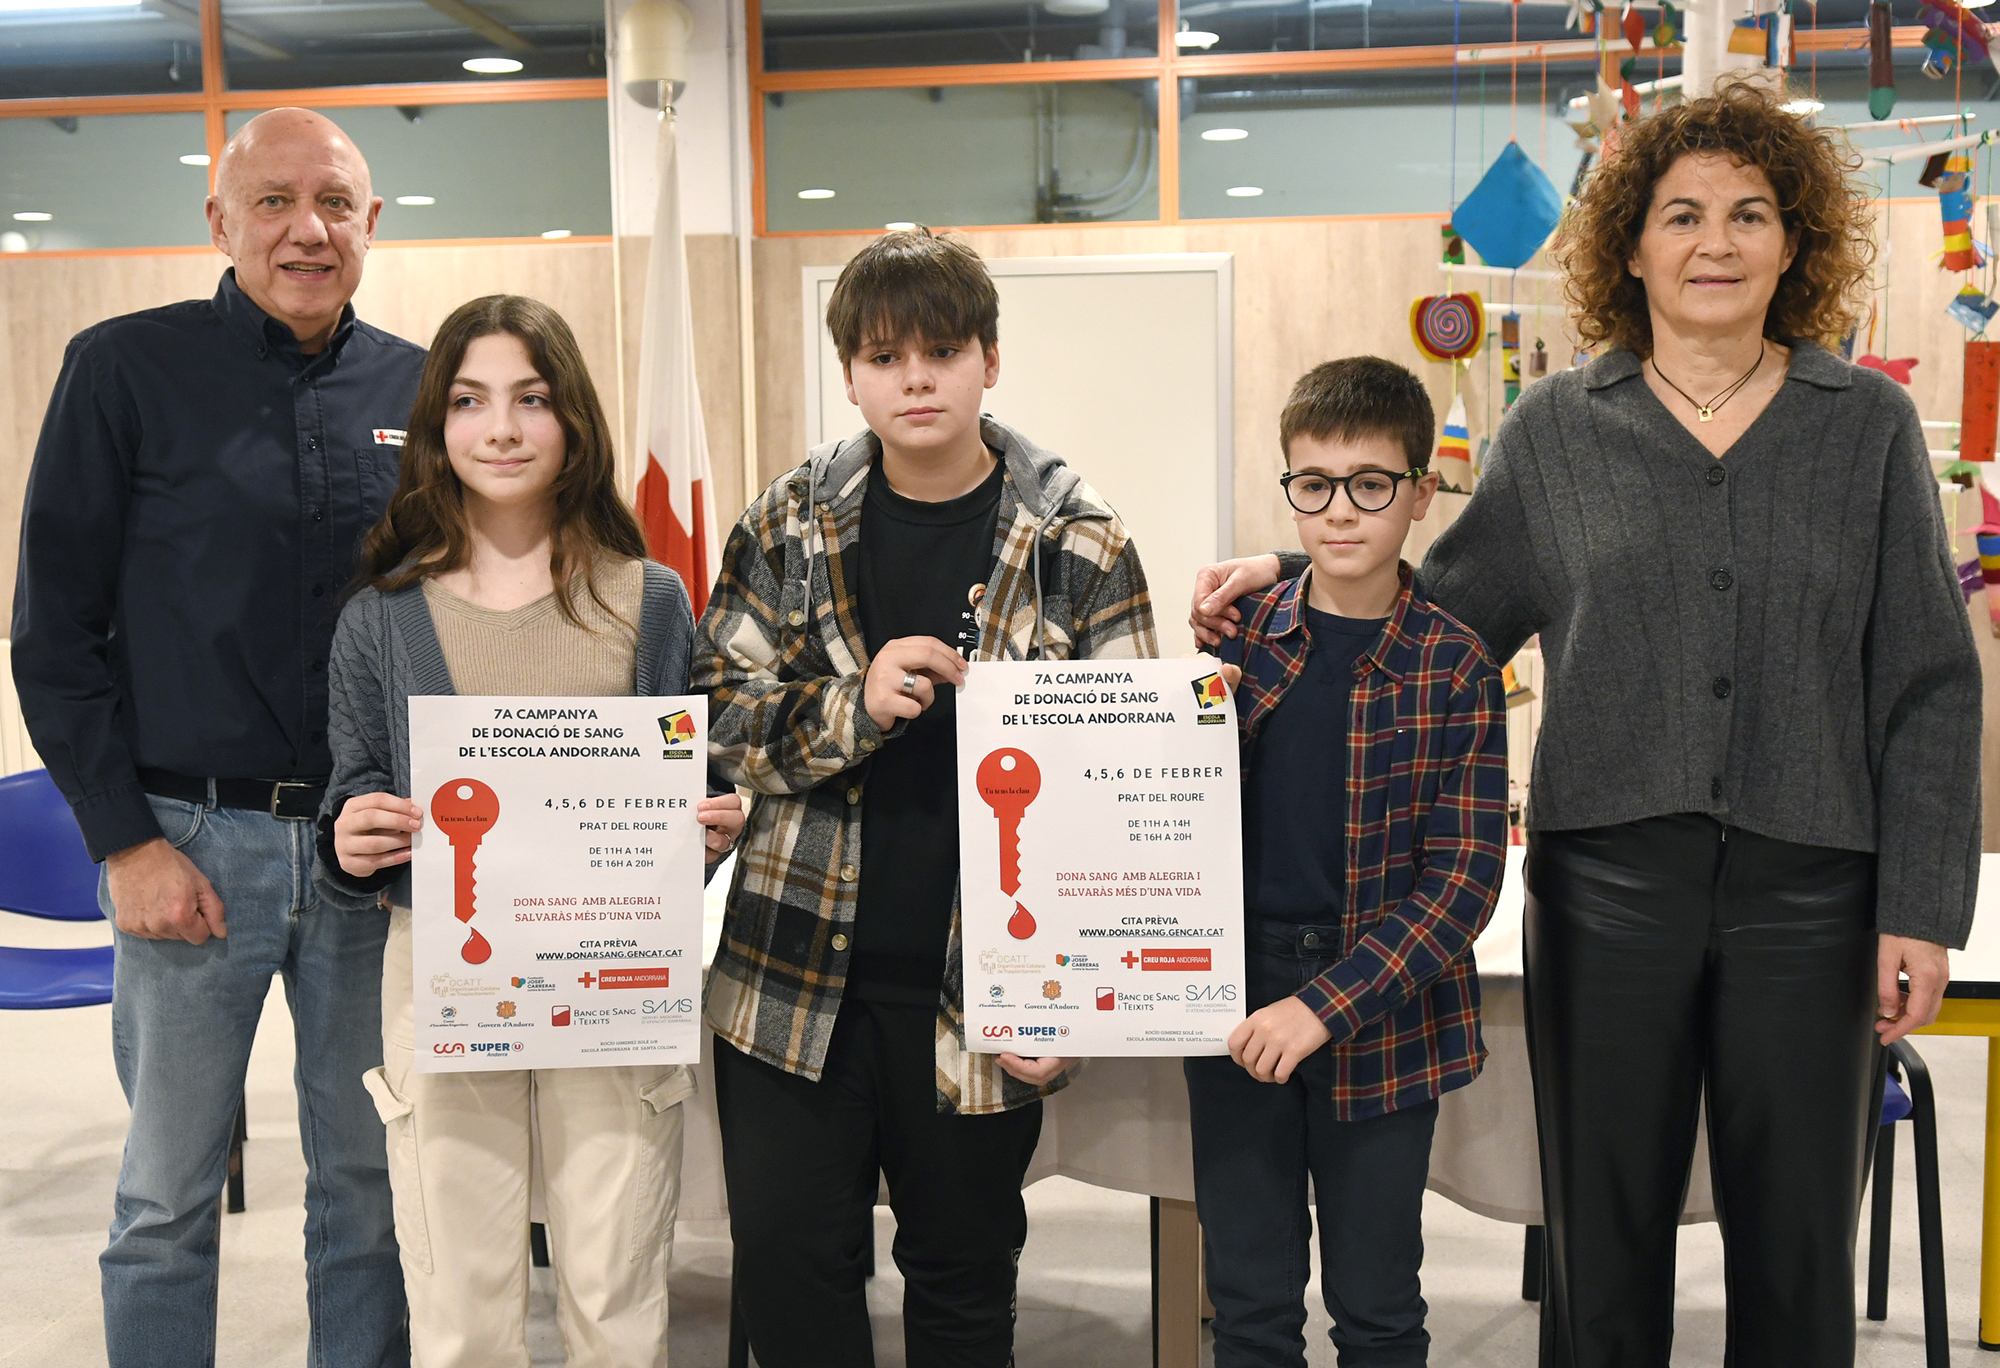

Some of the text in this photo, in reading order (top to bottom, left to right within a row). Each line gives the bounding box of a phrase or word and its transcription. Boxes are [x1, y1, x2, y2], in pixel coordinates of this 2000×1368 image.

[1035, 672, 1134, 685] 7A CAMPANYA
[1014, 690, 1158, 705] DE DONACIÓ DE SANG
[494, 708, 598, 720] 7A CAMPANYA
[1002, 712, 1176, 725] DE L'ESCOLA ANDORRANA
[472, 725, 624, 738] DE DONACIÓ DE SANG
[459, 747, 640, 758] DE L'ESCOLA ANDORRANA
[1084, 766, 1223, 782] 4,5,6 DE FEBRER
[1118, 793, 1204, 802] PRAT DEL ROURE
[545, 798, 688, 810] 4,5,6 DE FEBRER
[580, 822, 668, 831] PRAT DEL ROURE
[1128, 819, 1190, 828] DE 11H A 14H
[1130, 832, 1192, 842] DE 16H A 20H
[590, 847, 653, 855] DE 11H A 14H
[590, 860, 654, 868] DE 16H A 20H
[1056, 872, 1200, 881] DONA SANG AMB ALEGRIA I
[1058, 886, 1114, 897] SALVARÀS
[1116, 885, 1137, 897] MÉS
[1175, 886, 1202, 896] VIDA
[513, 896, 661, 907] DONA SANG AMB ALEGRIA I
[514, 911, 572, 922] SALVARÀS
[574, 910, 597, 921] MÉS
[635, 911, 661, 920] VIDA
[1121, 914, 1178, 925] CITA PRÈVIA
[1079, 928, 1224, 937] WWW.DONARSANG.GENCAT.CAT
[580, 938, 637, 948] CITA PRÈVIA
[536, 950, 683, 961] WWW.DONARSANG.GENCAT.CAT
[996, 955, 1028, 963] OCATT
[449, 978, 482, 986] OCATT
[1018, 1026, 1056, 1036] SUPER
[470, 1043, 510, 1052] SUPER
